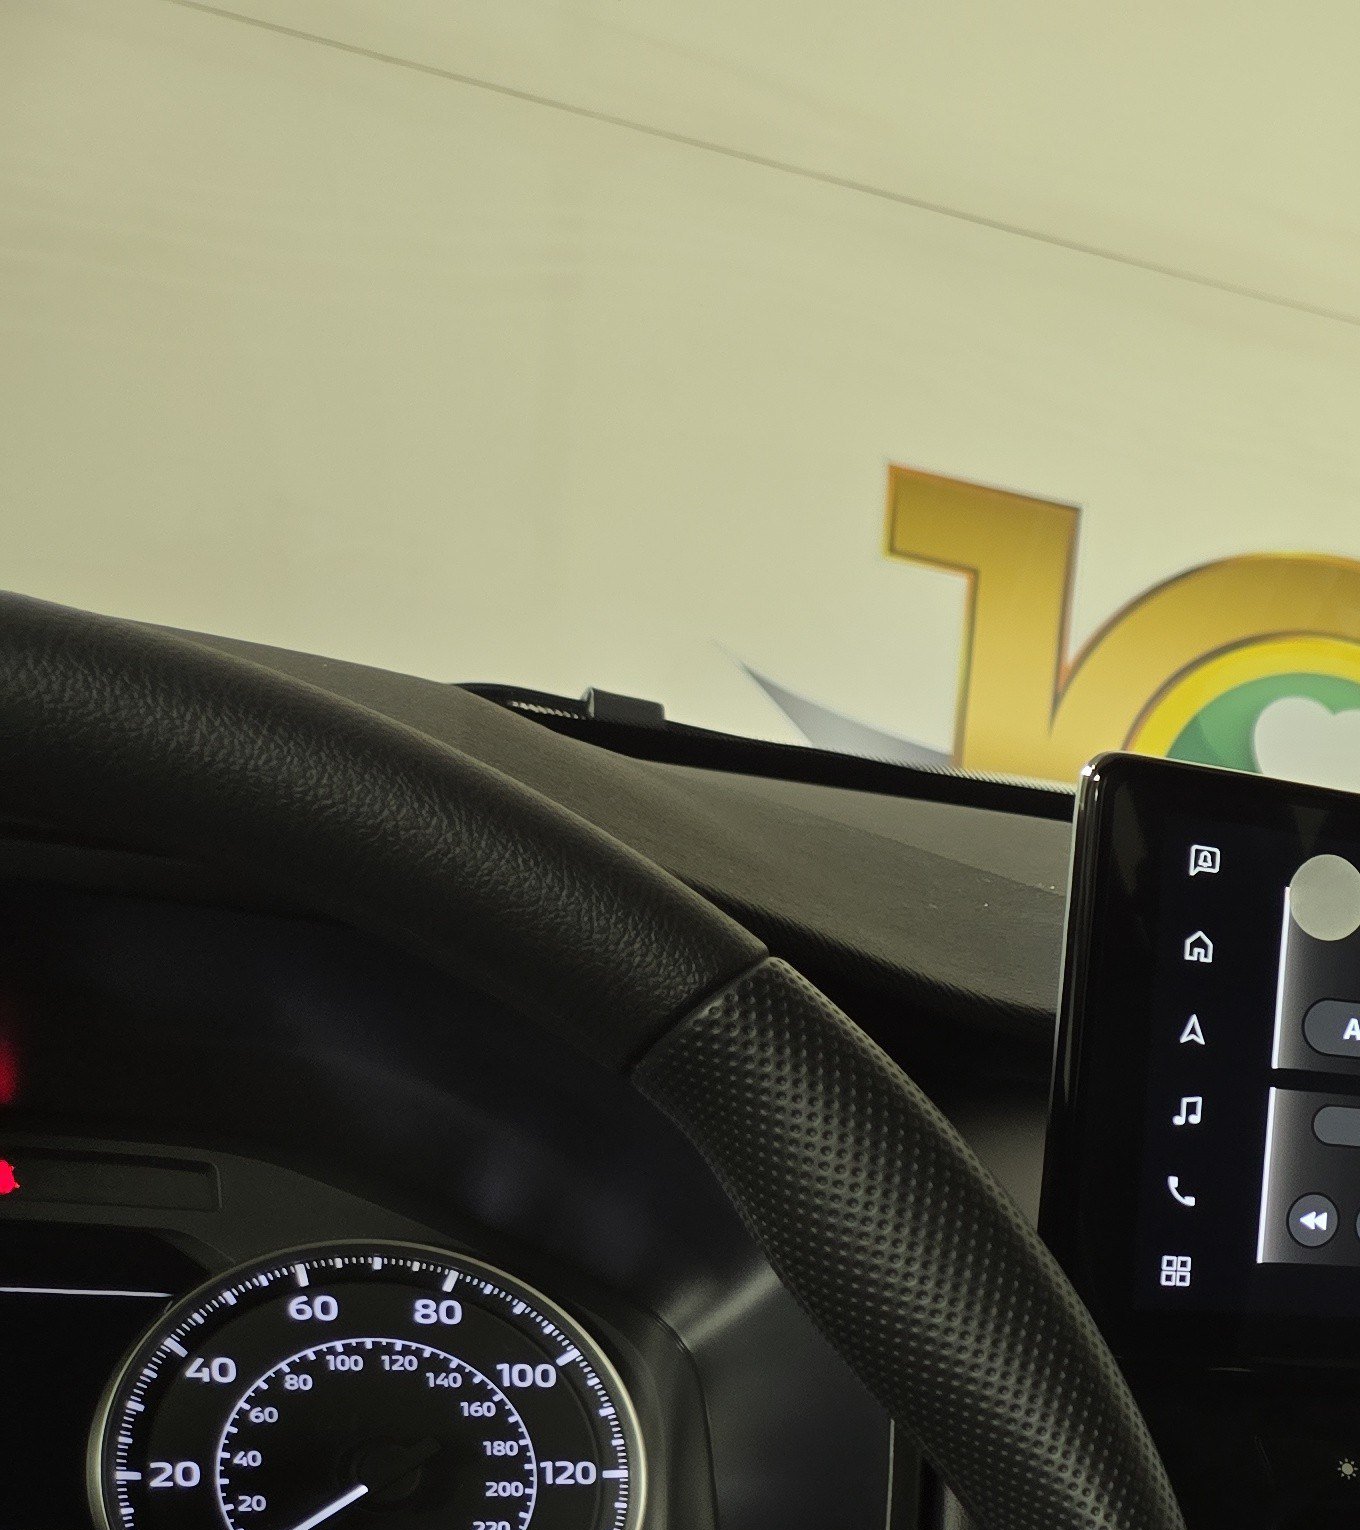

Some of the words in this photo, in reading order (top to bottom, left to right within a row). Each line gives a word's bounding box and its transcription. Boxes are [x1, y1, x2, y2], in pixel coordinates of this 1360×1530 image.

[287, 1296, 338, 1322] 60
[413, 1300, 463, 1326] 80
[184, 1357, 237, 1384] 40
[326, 1355, 364, 1371] 100
[382, 1355, 419, 1371] 120
[285, 1374, 313, 1391] 80
[426, 1372, 463, 1388] 140
[496, 1363, 557, 1388] 100
[250, 1407, 279, 1423] 60
[460, 1402, 496, 1418] 160
[483, 1440, 519, 1456] 180
[233, 1451, 262, 1467] 40
[149, 1461, 201, 1488] 20
[541, 1461, 597, 1485] 120
[485, 1481, 523, 1498] 200
[238, 1496, 266, 1512] 20
